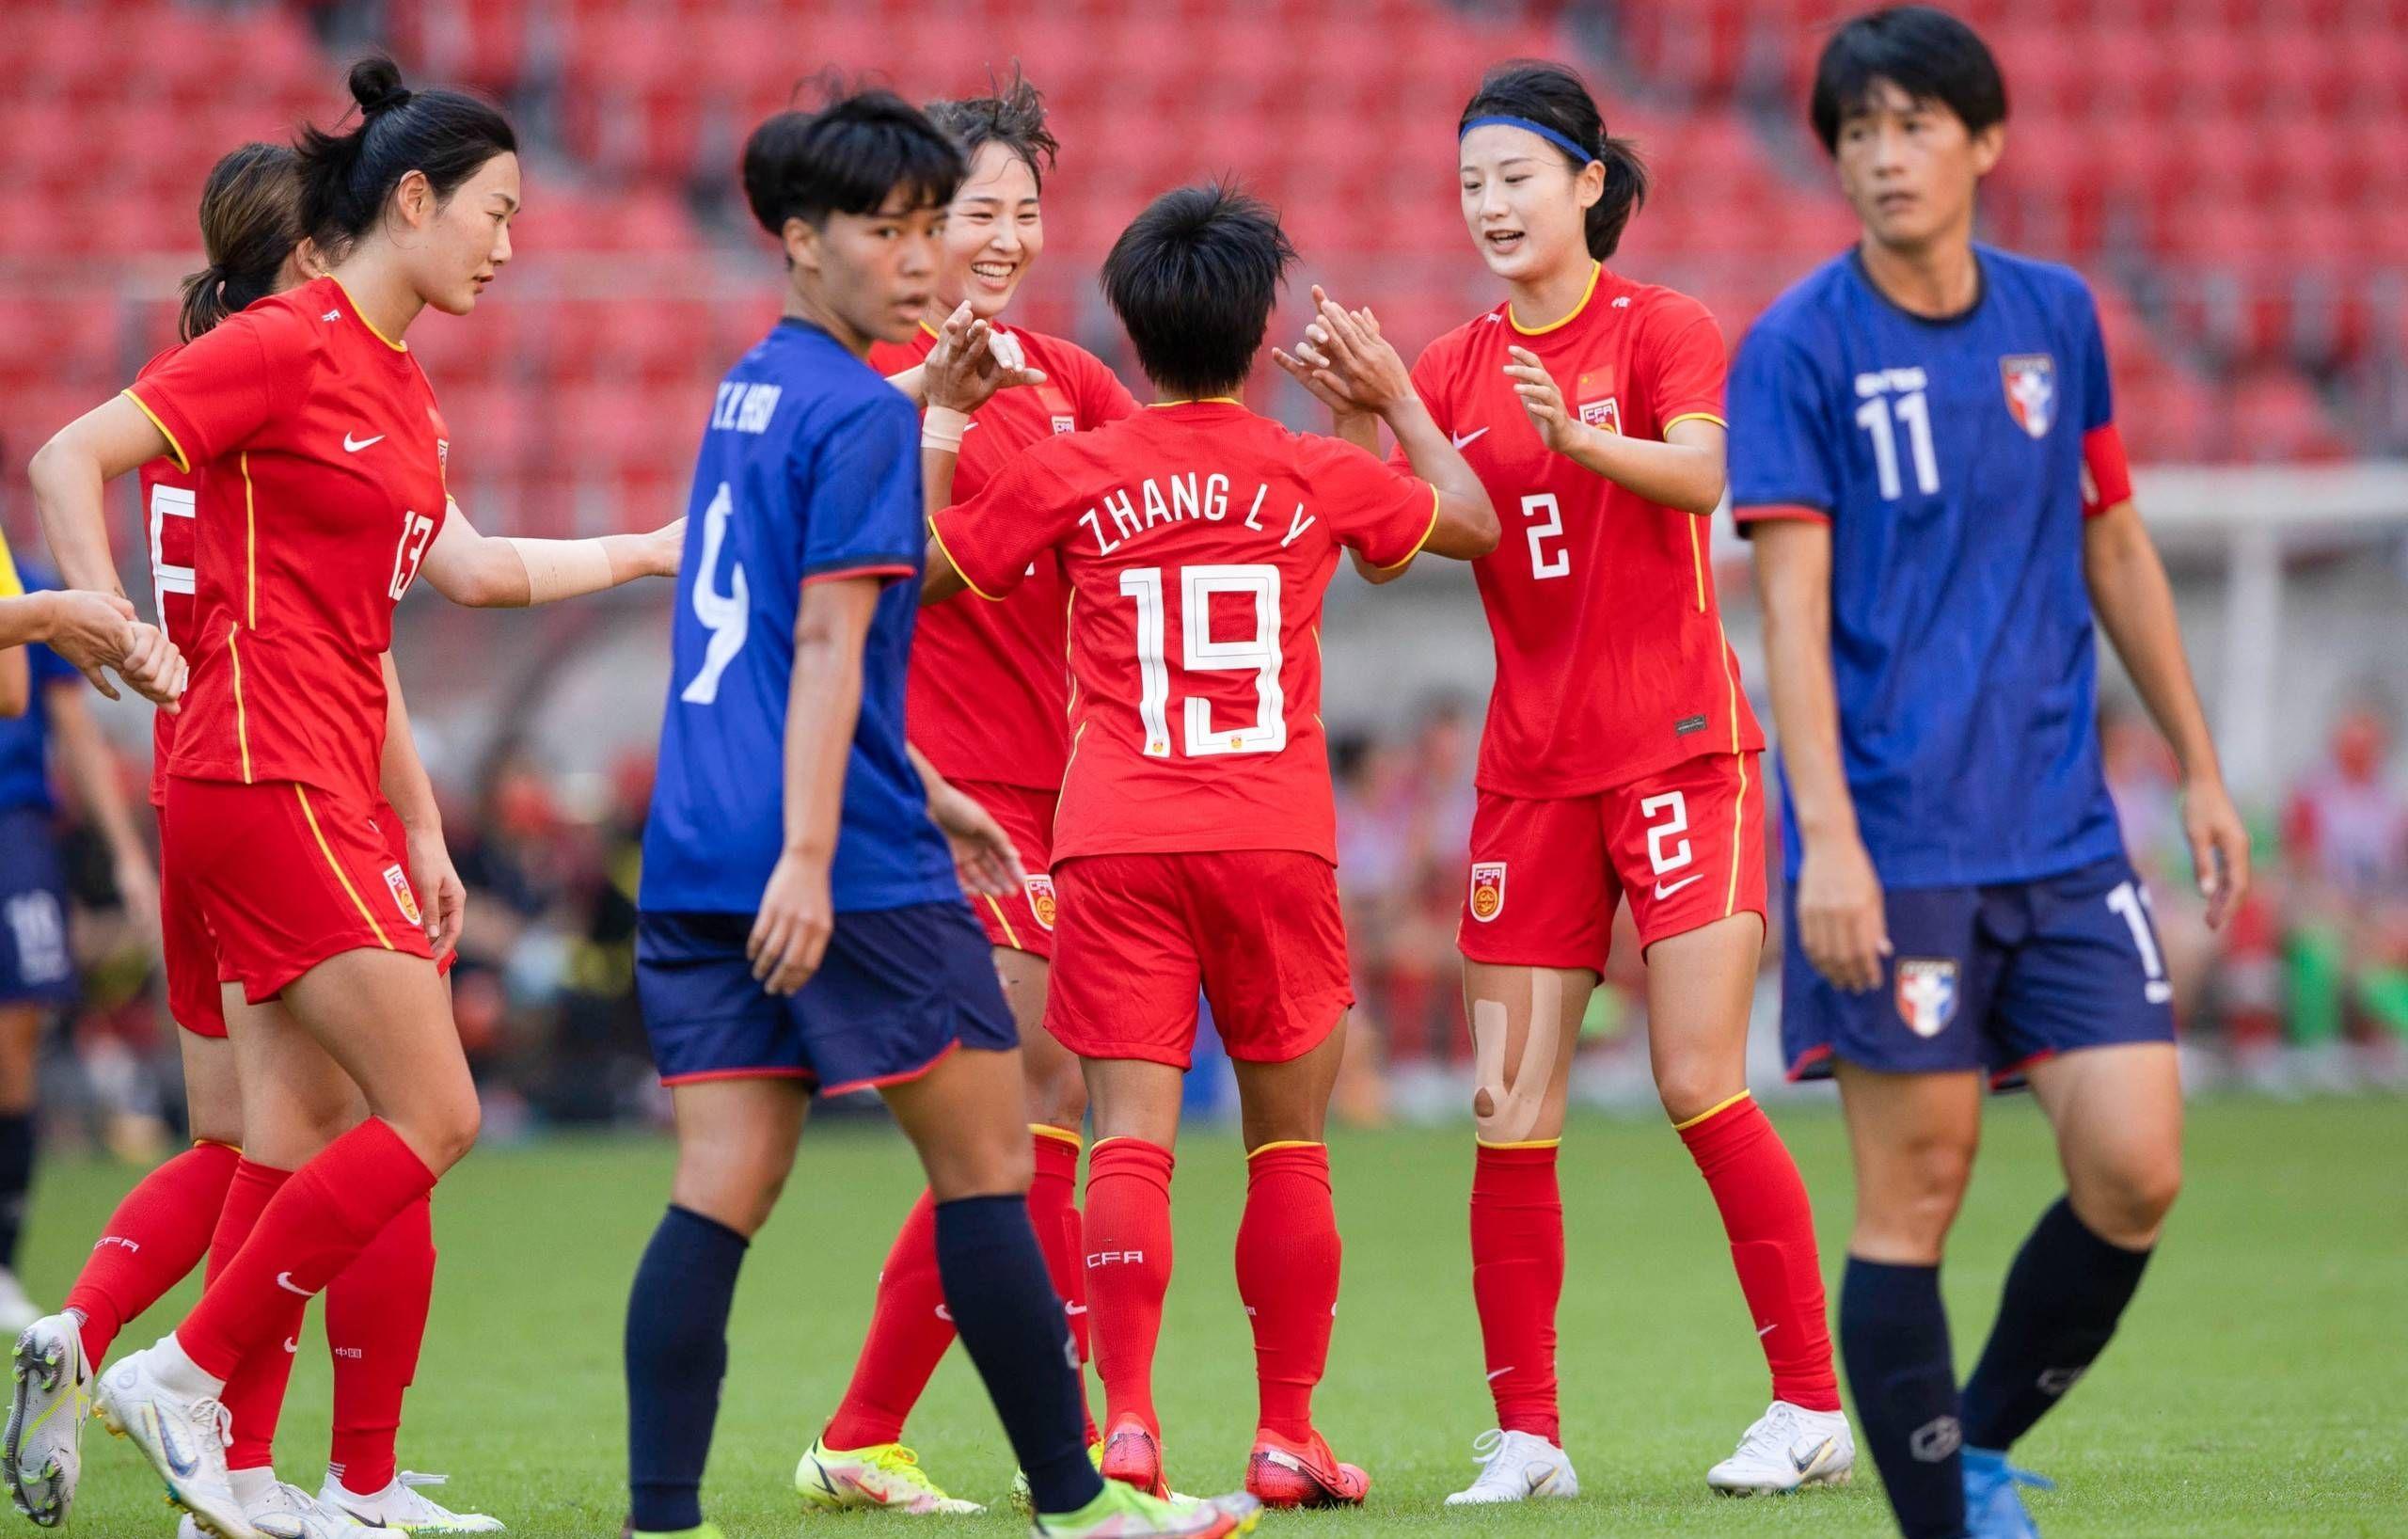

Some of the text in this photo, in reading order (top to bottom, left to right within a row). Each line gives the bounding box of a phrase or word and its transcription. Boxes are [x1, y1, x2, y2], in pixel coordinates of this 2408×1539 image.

[1855, 390, 1940, 501] 11
[388, 510, 435, 601] 13
[1078, 472, 1229, 556] ZHANG
[1520, 492, 1571, 580] 2
[1119, 563, 1287, 758] 19
[1640, 790, 1693, 876] 2
[2105, 881, 2162, 978] 1
[1087, 1250, 1143, 1268] CFA
